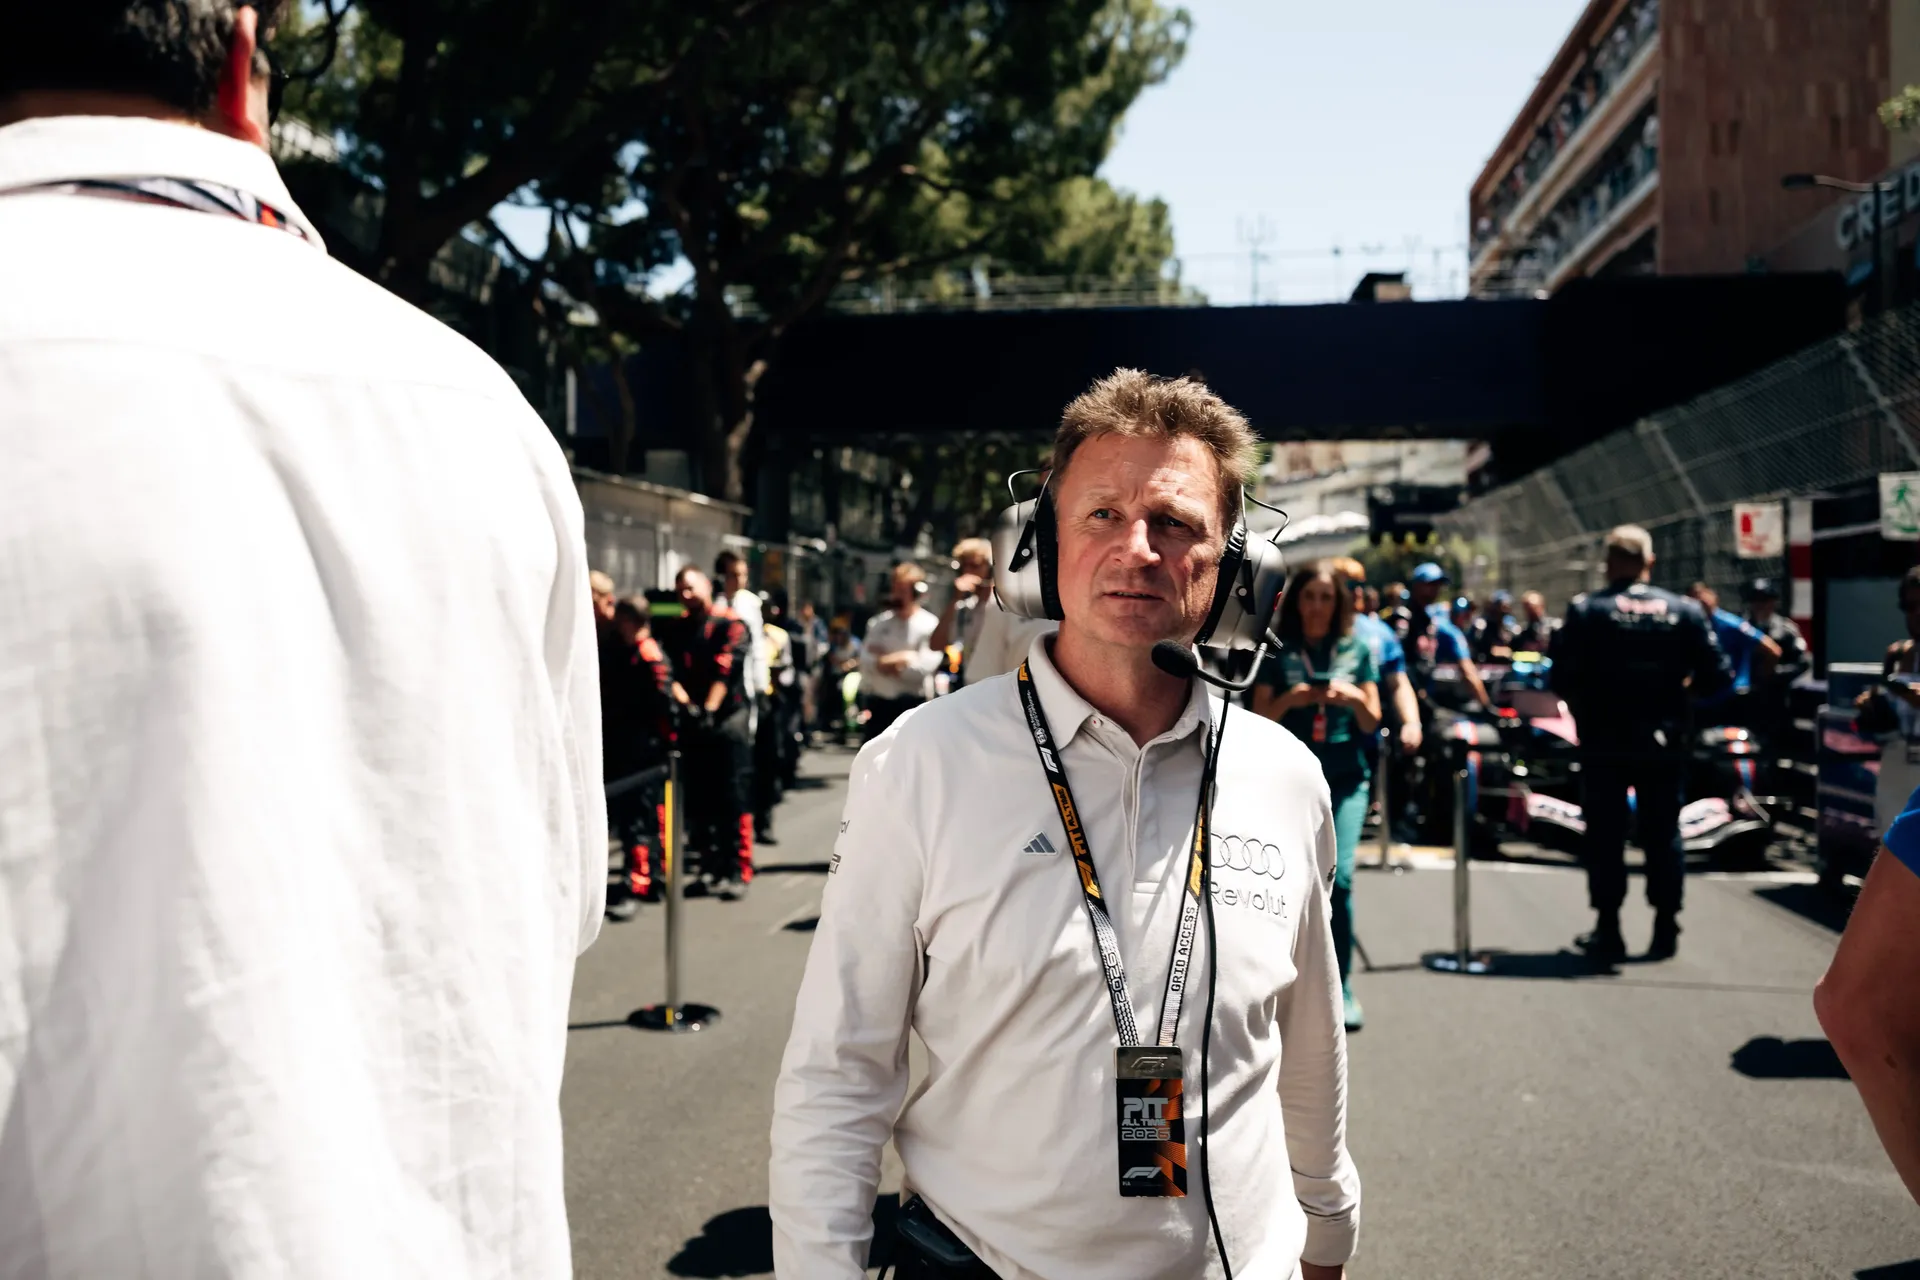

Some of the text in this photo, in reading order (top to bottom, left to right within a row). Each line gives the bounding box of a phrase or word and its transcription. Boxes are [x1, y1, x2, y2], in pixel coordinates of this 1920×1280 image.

[1210, 881, 1287, 919] Revolut
[1170, 906, 1195, 992] GRID ACCESS
[1106, 951, 1127, 1005] 2026
[1122, 1119, 1167, 1127] ALL TIME
[1123, 1097, 1169, 1119] PIT
[1121, 1128, 1171, 1141] 2026
